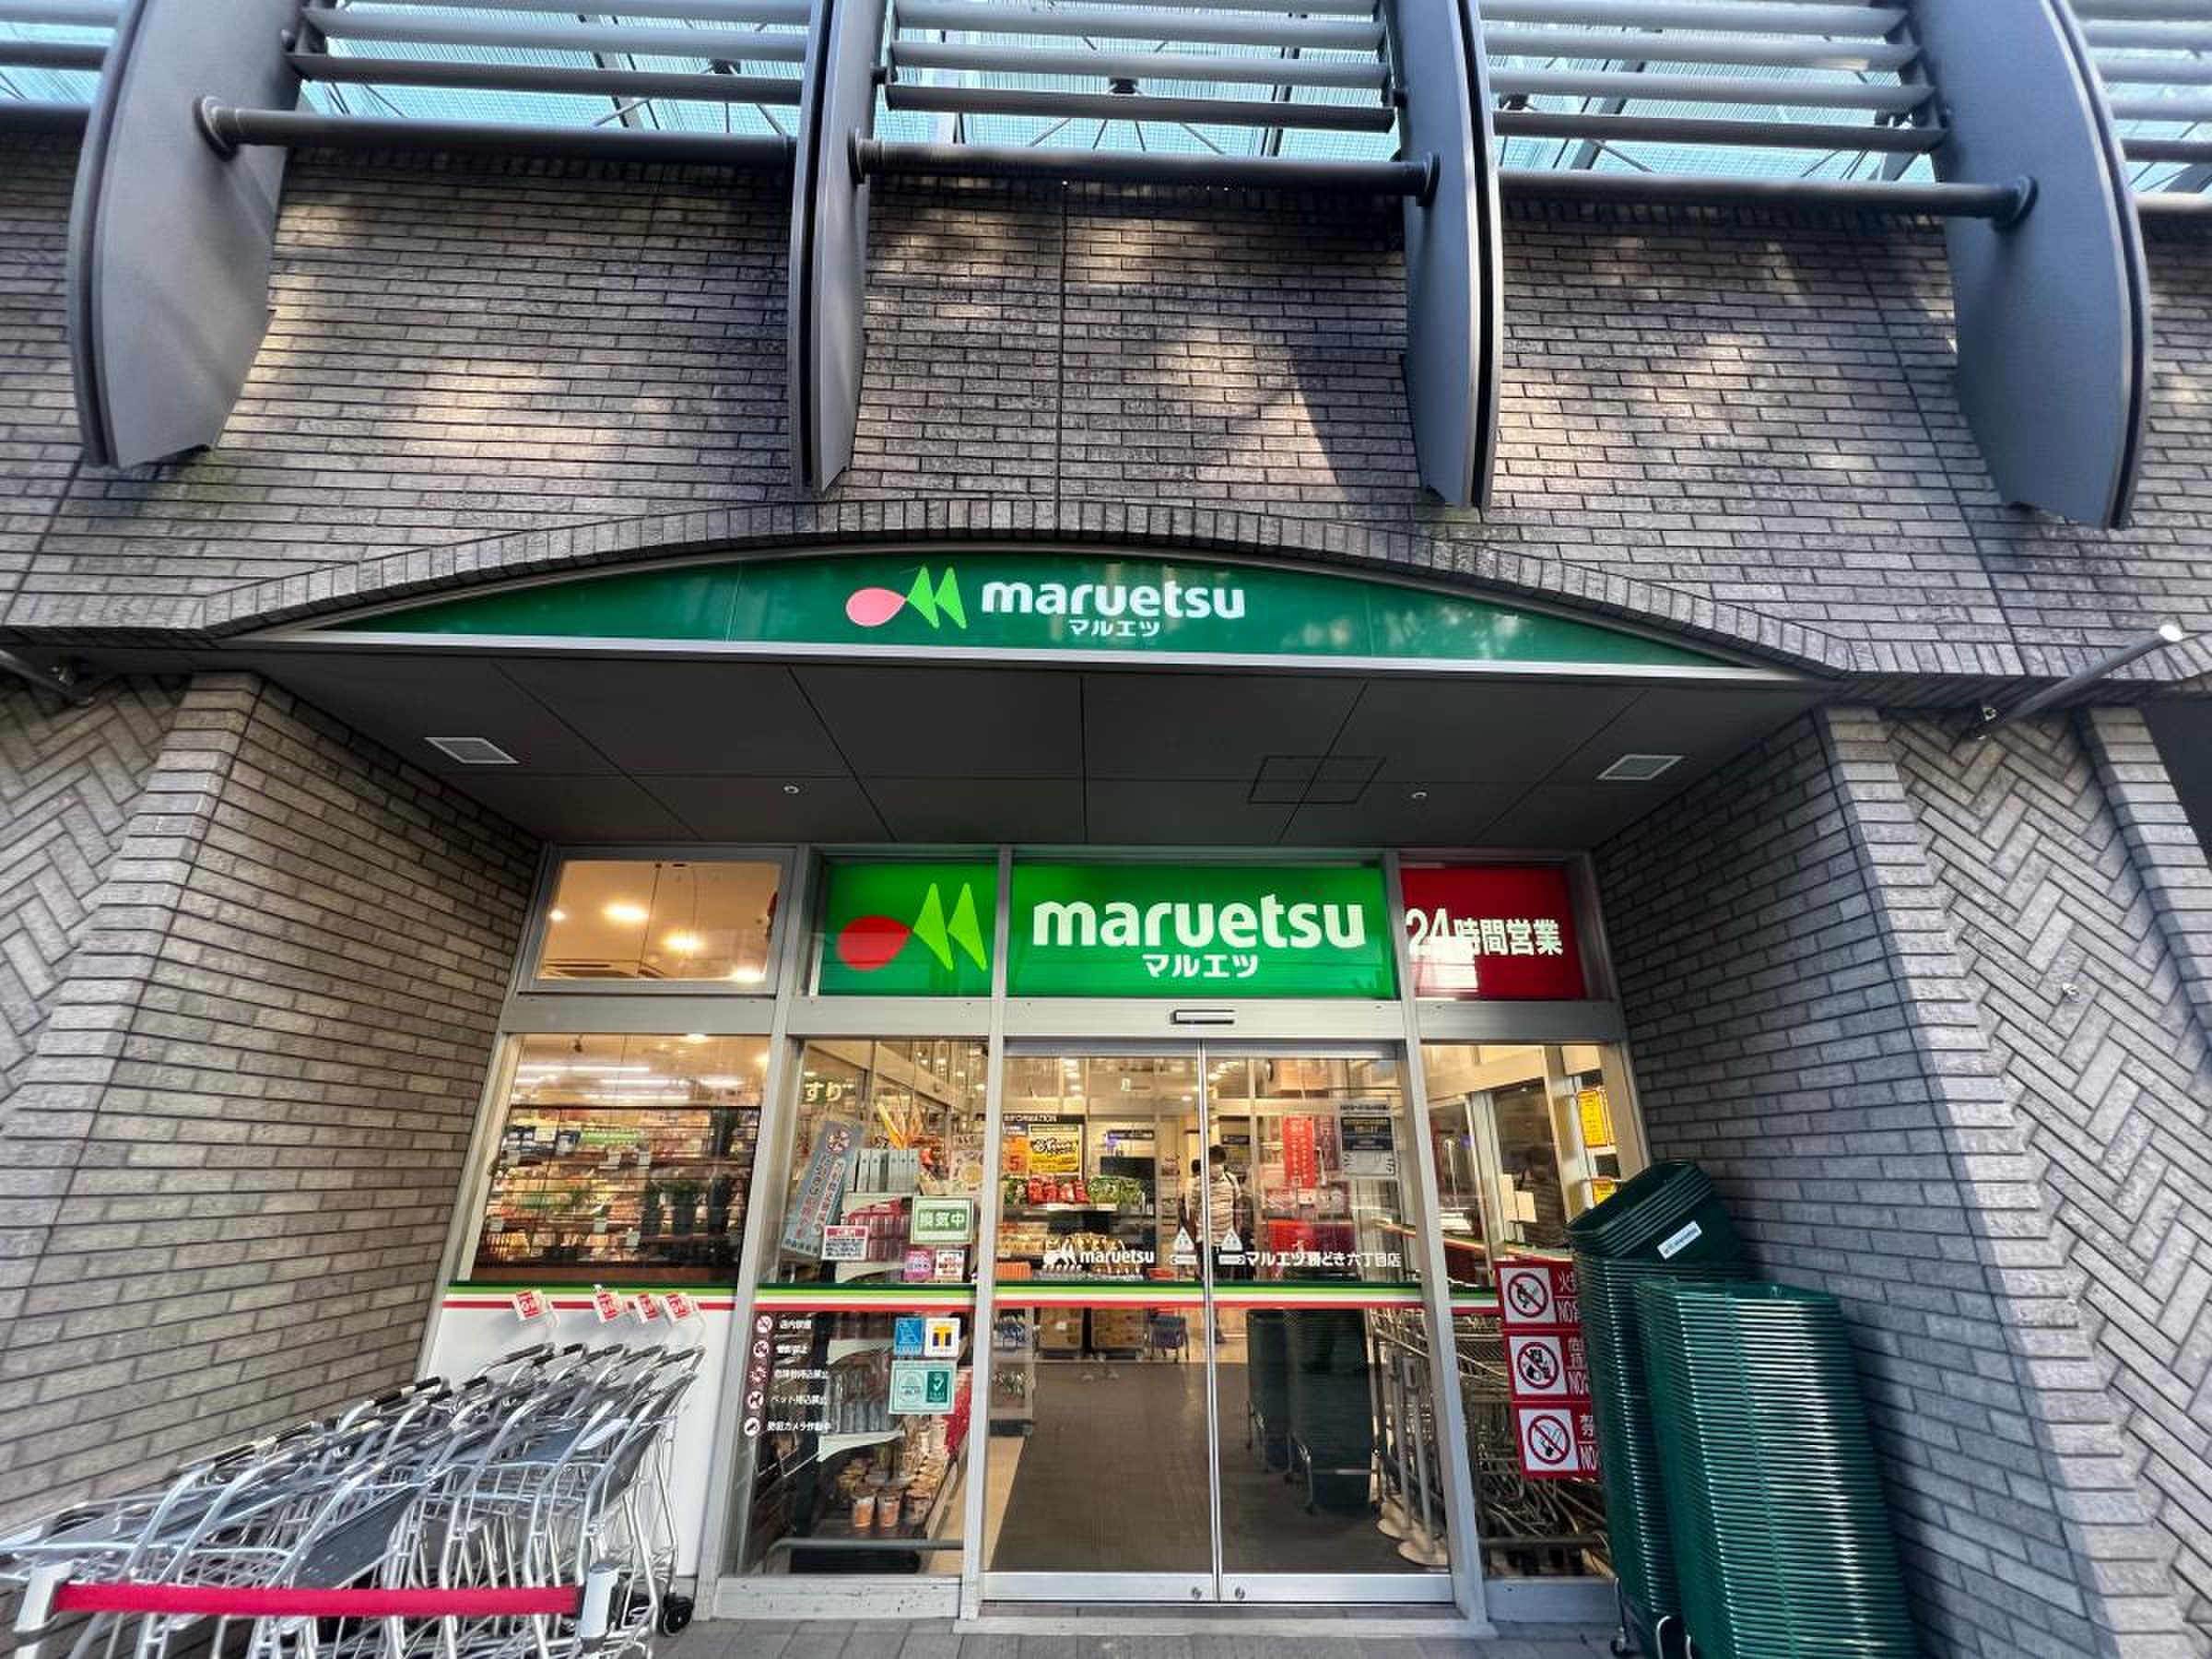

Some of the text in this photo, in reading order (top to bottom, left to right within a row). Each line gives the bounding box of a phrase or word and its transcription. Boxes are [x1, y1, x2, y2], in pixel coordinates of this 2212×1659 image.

[982, 581, 1246, 619] maruetsu
[1069, 619, 1161, 638] マルエツ
[1033, 893, 1366, 949] maruetsu
[1405, 907, 1564, 957] 24時間営業
[1142, 954, 1259, 979] マルエツ
[1080, 1250, 1154, 1264] maruetsu
